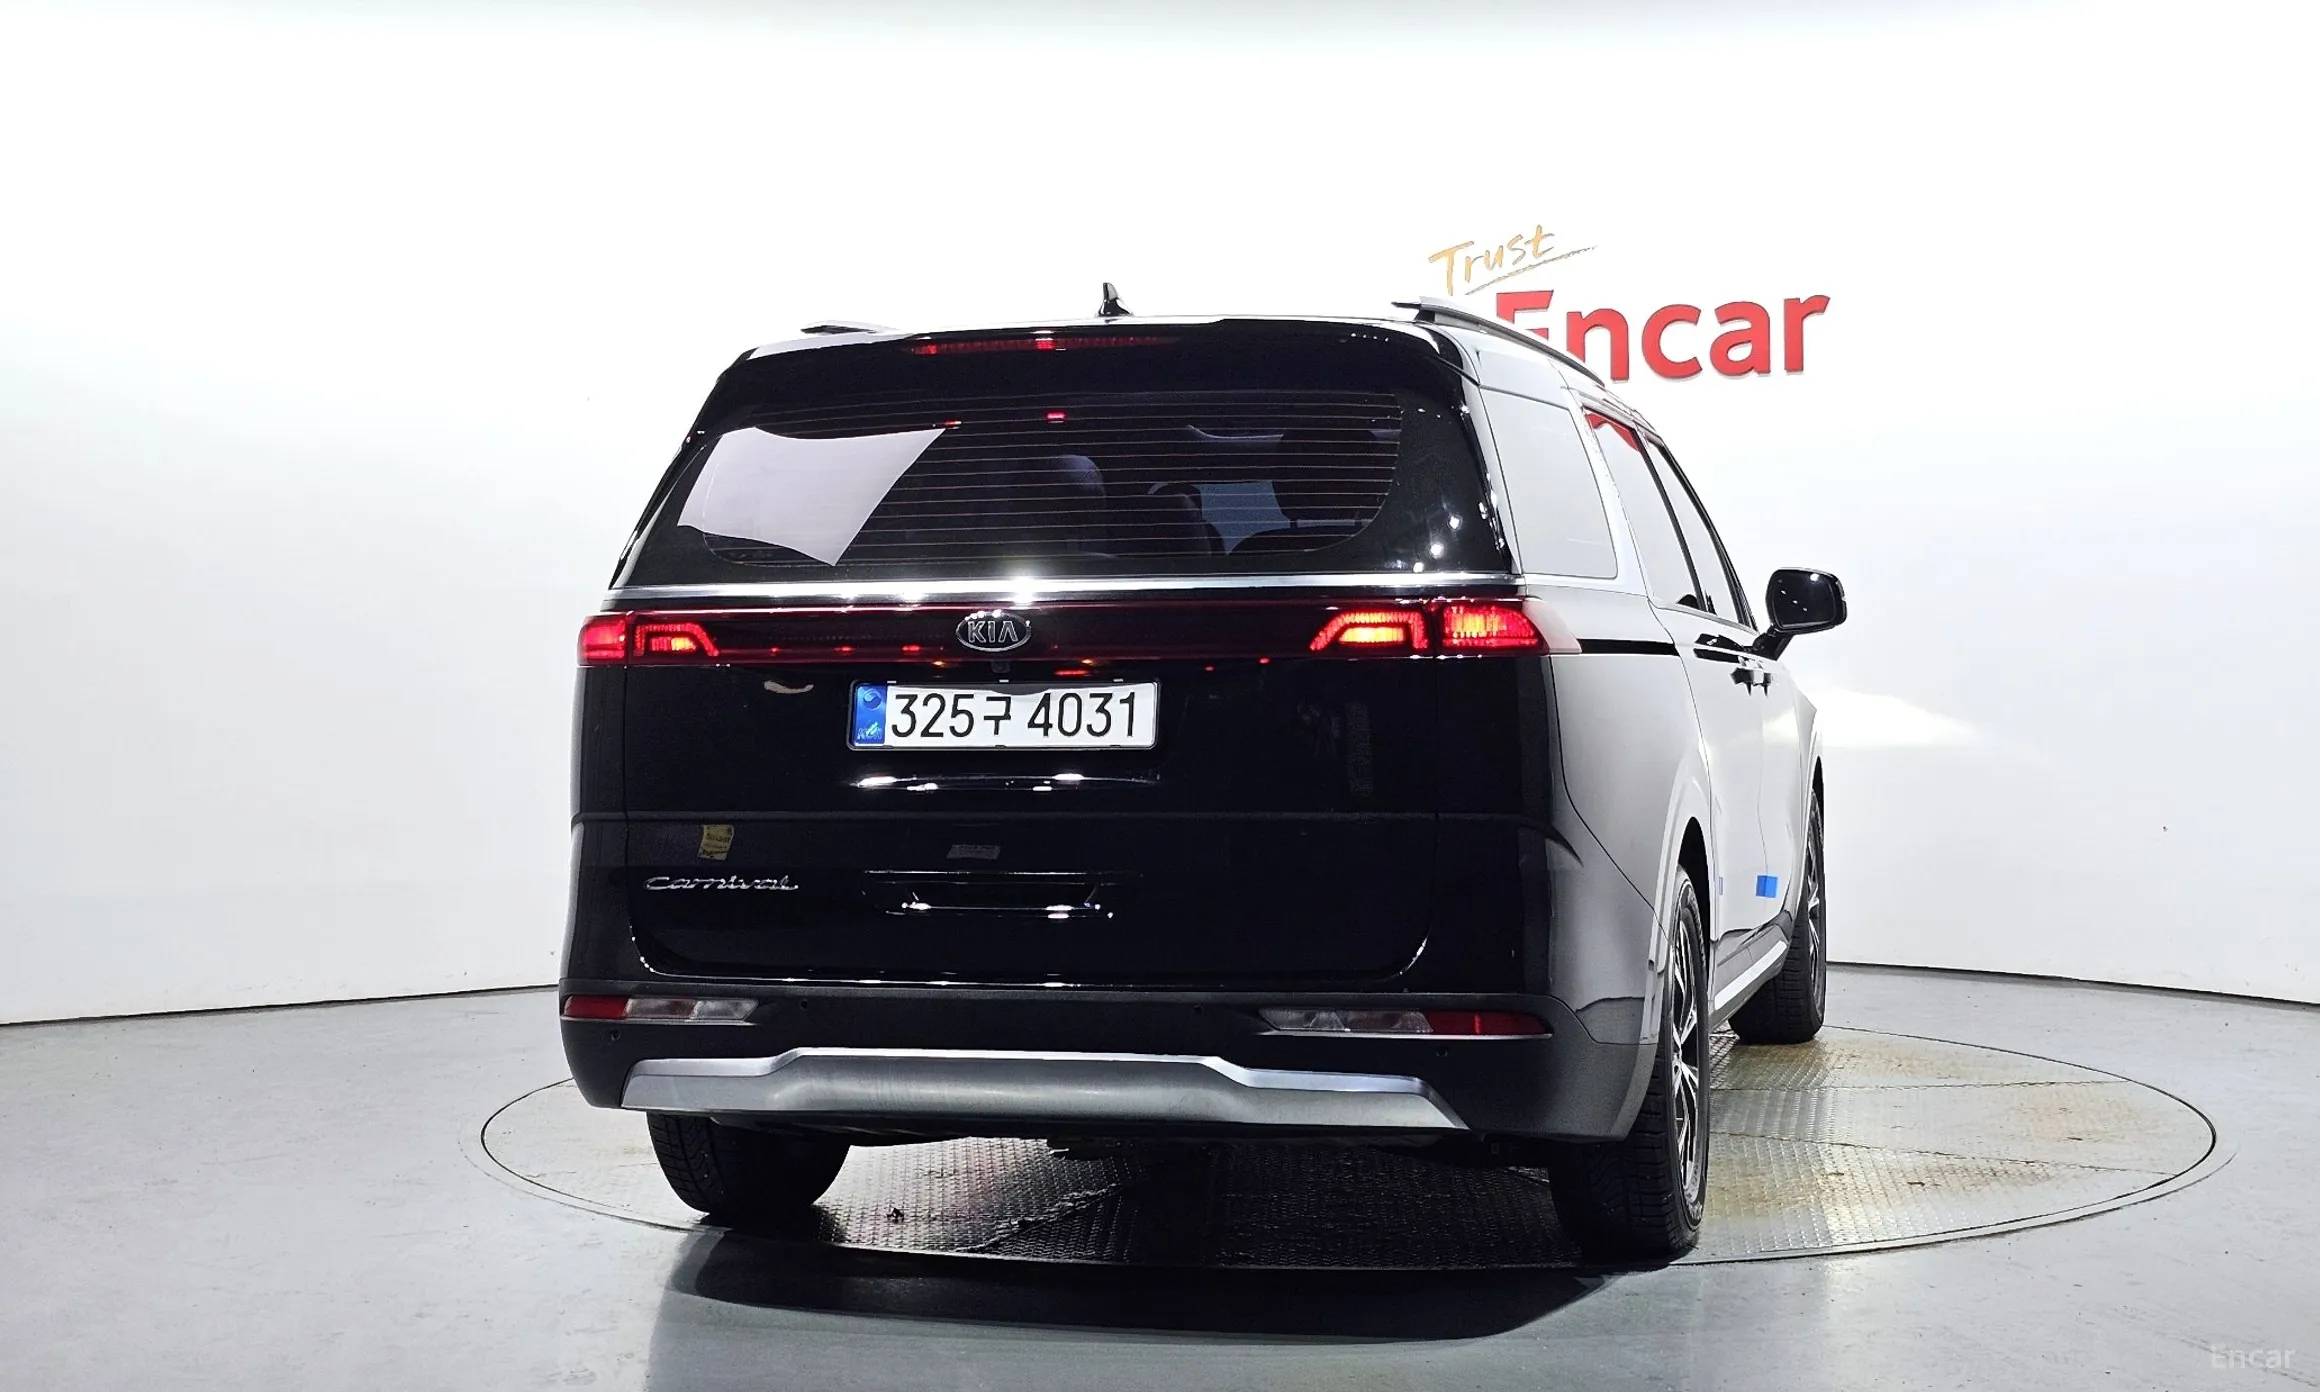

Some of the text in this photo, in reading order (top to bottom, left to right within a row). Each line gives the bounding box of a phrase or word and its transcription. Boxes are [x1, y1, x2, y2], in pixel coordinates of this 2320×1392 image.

[1428, 224, 1556, 296] Trust
[967, 620, 1019, 644] KIA
[892, 692, 1136, 738] 325구 4031
[645, 874, 799, 891] Carnival
